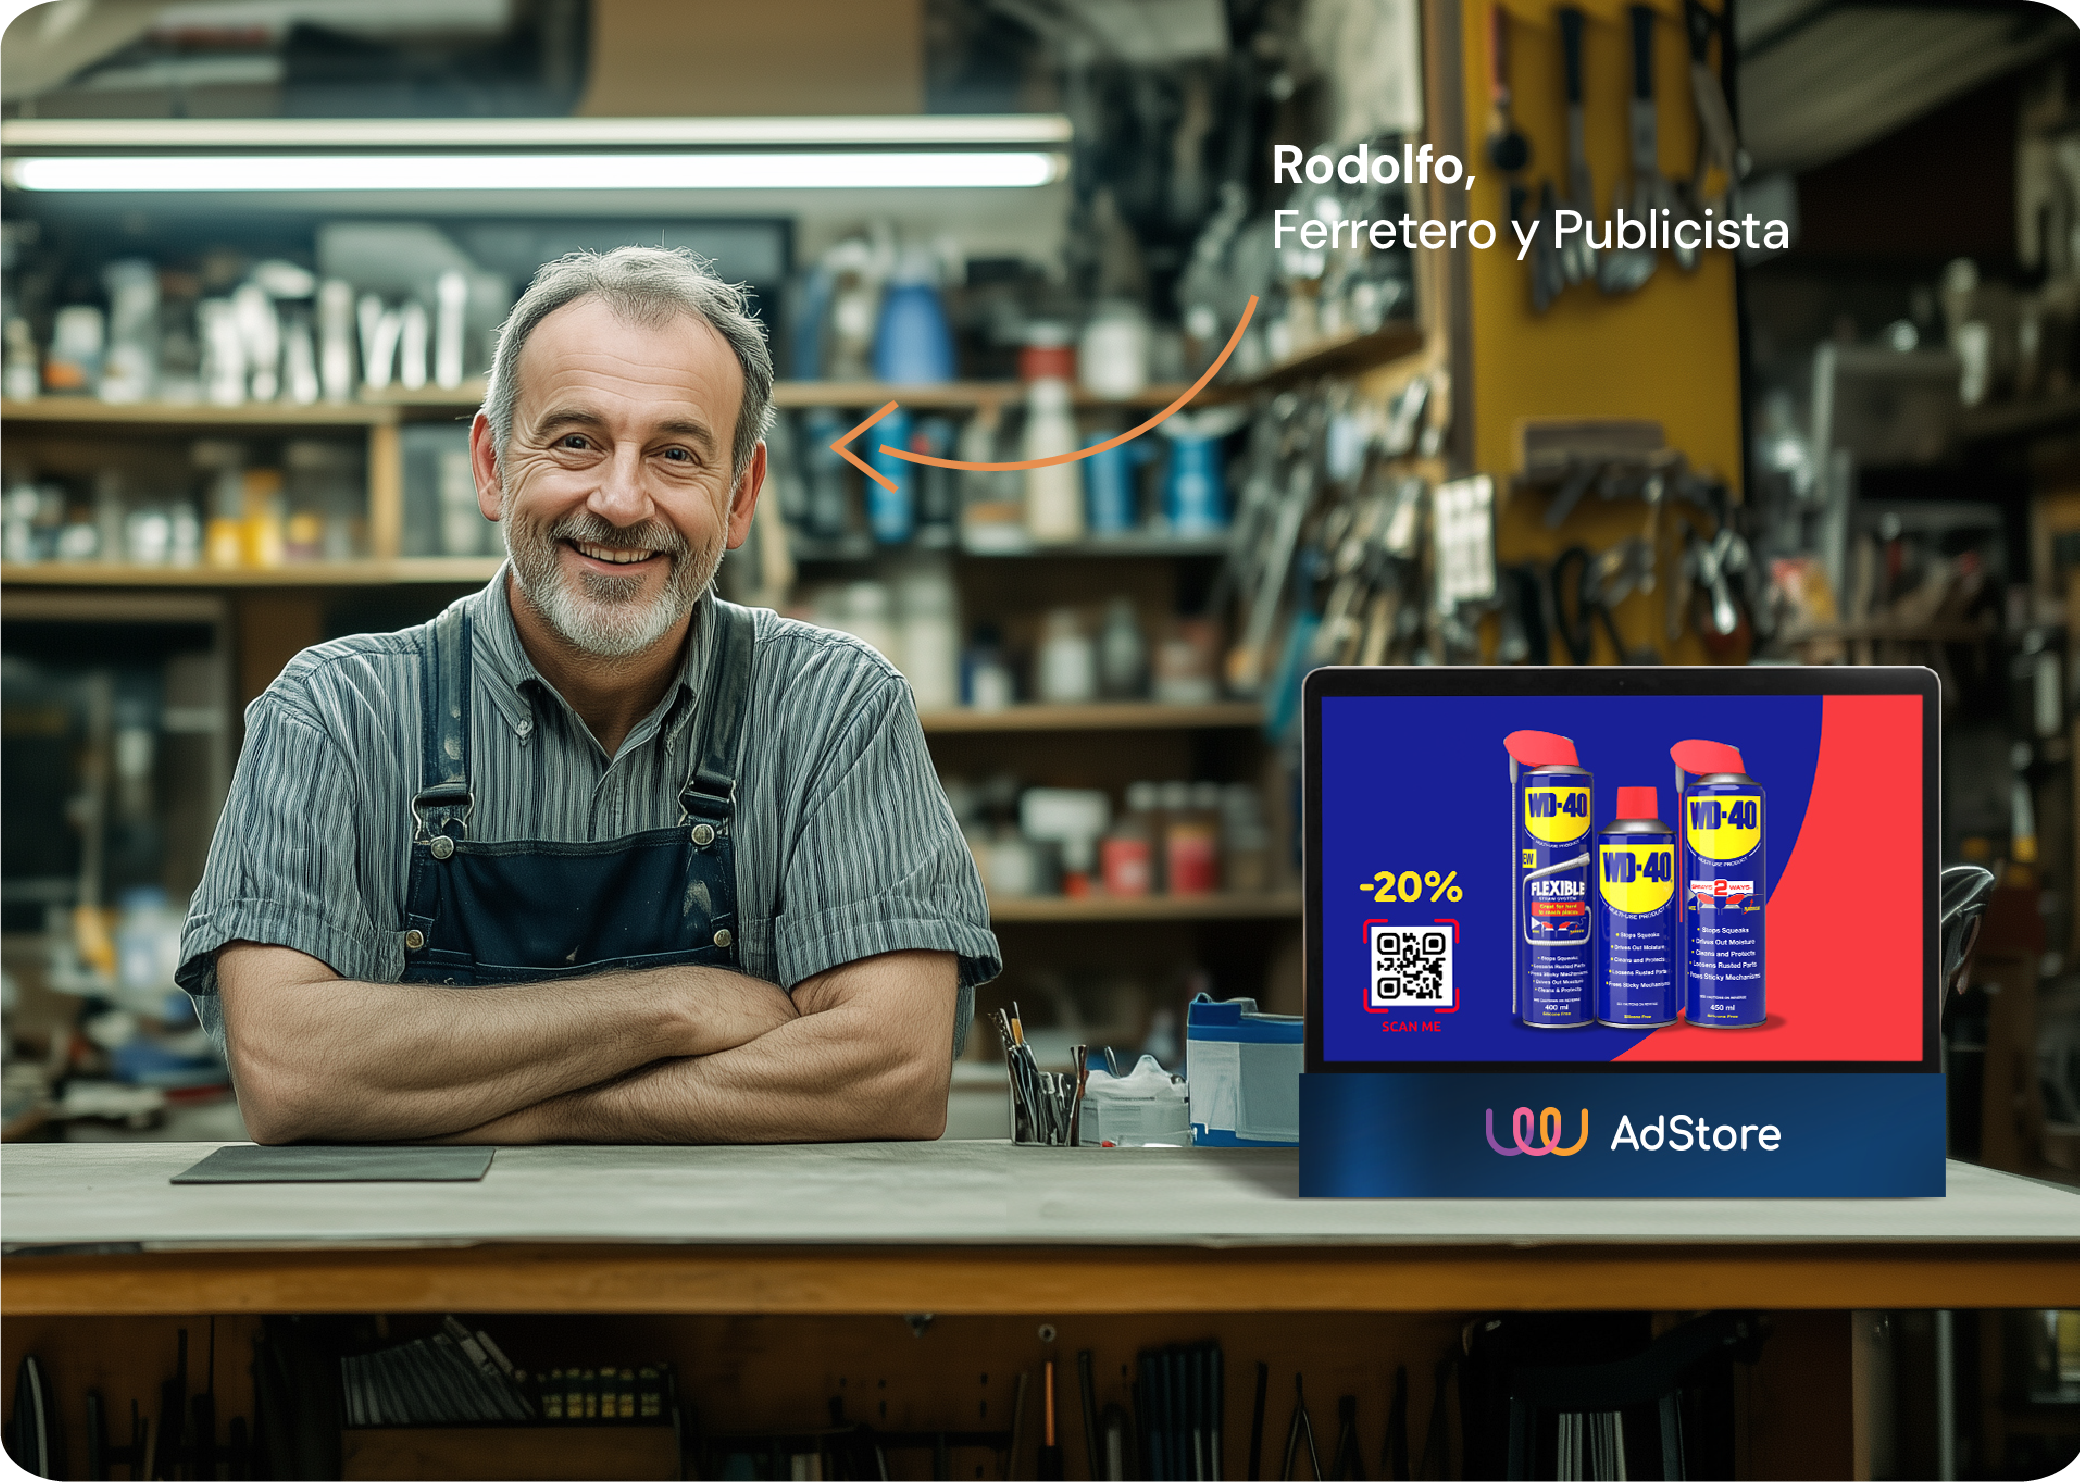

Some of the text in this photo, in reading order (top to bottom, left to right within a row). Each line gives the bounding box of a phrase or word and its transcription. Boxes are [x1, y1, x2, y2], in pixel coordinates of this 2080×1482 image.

[1528, 792, 1588, 818] WD-40
[1690, 800, 1758, 830] WD-40
[1602, 852, 1672, 882] WD-40
[1359, 870, 1463, 903] -20%
[1531, 880, 1586, 896] FLEXIBLE
[1713, 879, 1728, 896] 2
[1382, 1021, 1441, 1032] SCAN ME
[1610, 1114, 1782, 1152] AdStore
